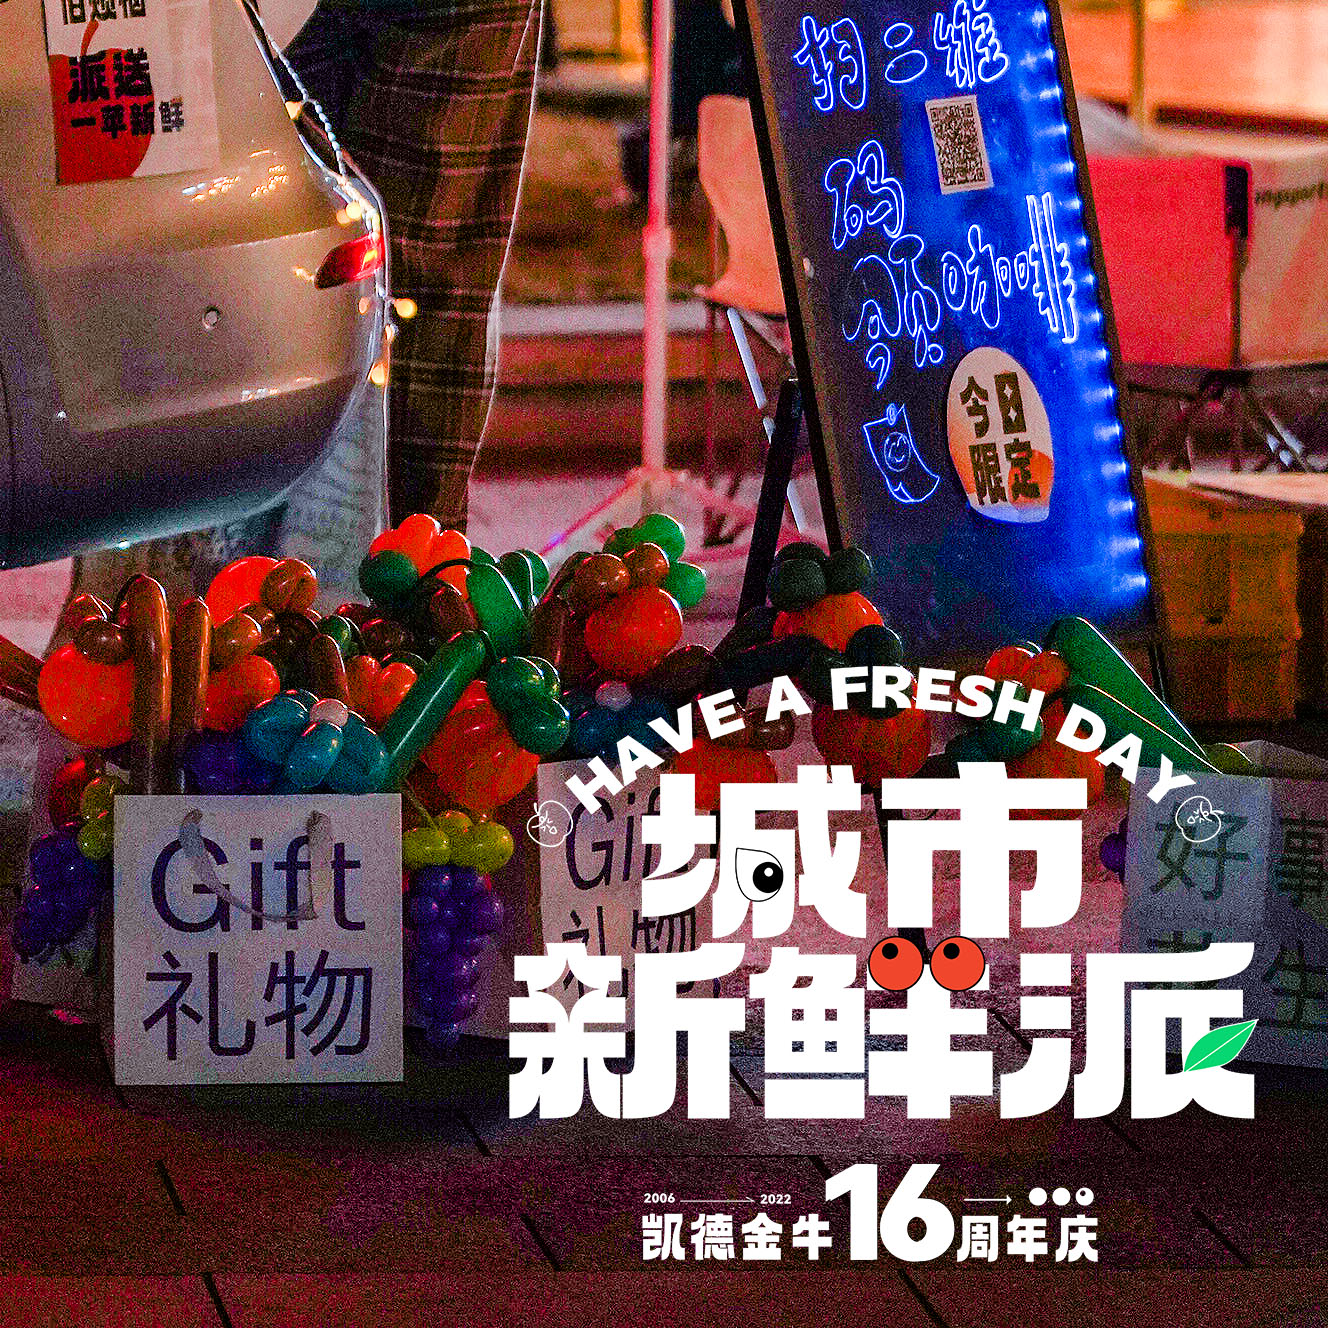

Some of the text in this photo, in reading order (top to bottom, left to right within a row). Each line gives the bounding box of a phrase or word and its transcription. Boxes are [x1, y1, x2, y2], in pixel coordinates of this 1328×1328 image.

[67, 46, 154, 104] 派送
[71, 95, 185, 140] 一苹新鲜
[959, 371, 1027, 439] 今日
[968, 438, 1042, 506] 限定
[150, 825, 364, 934] Gift
[142, 949, 373, 1062] 礼物
